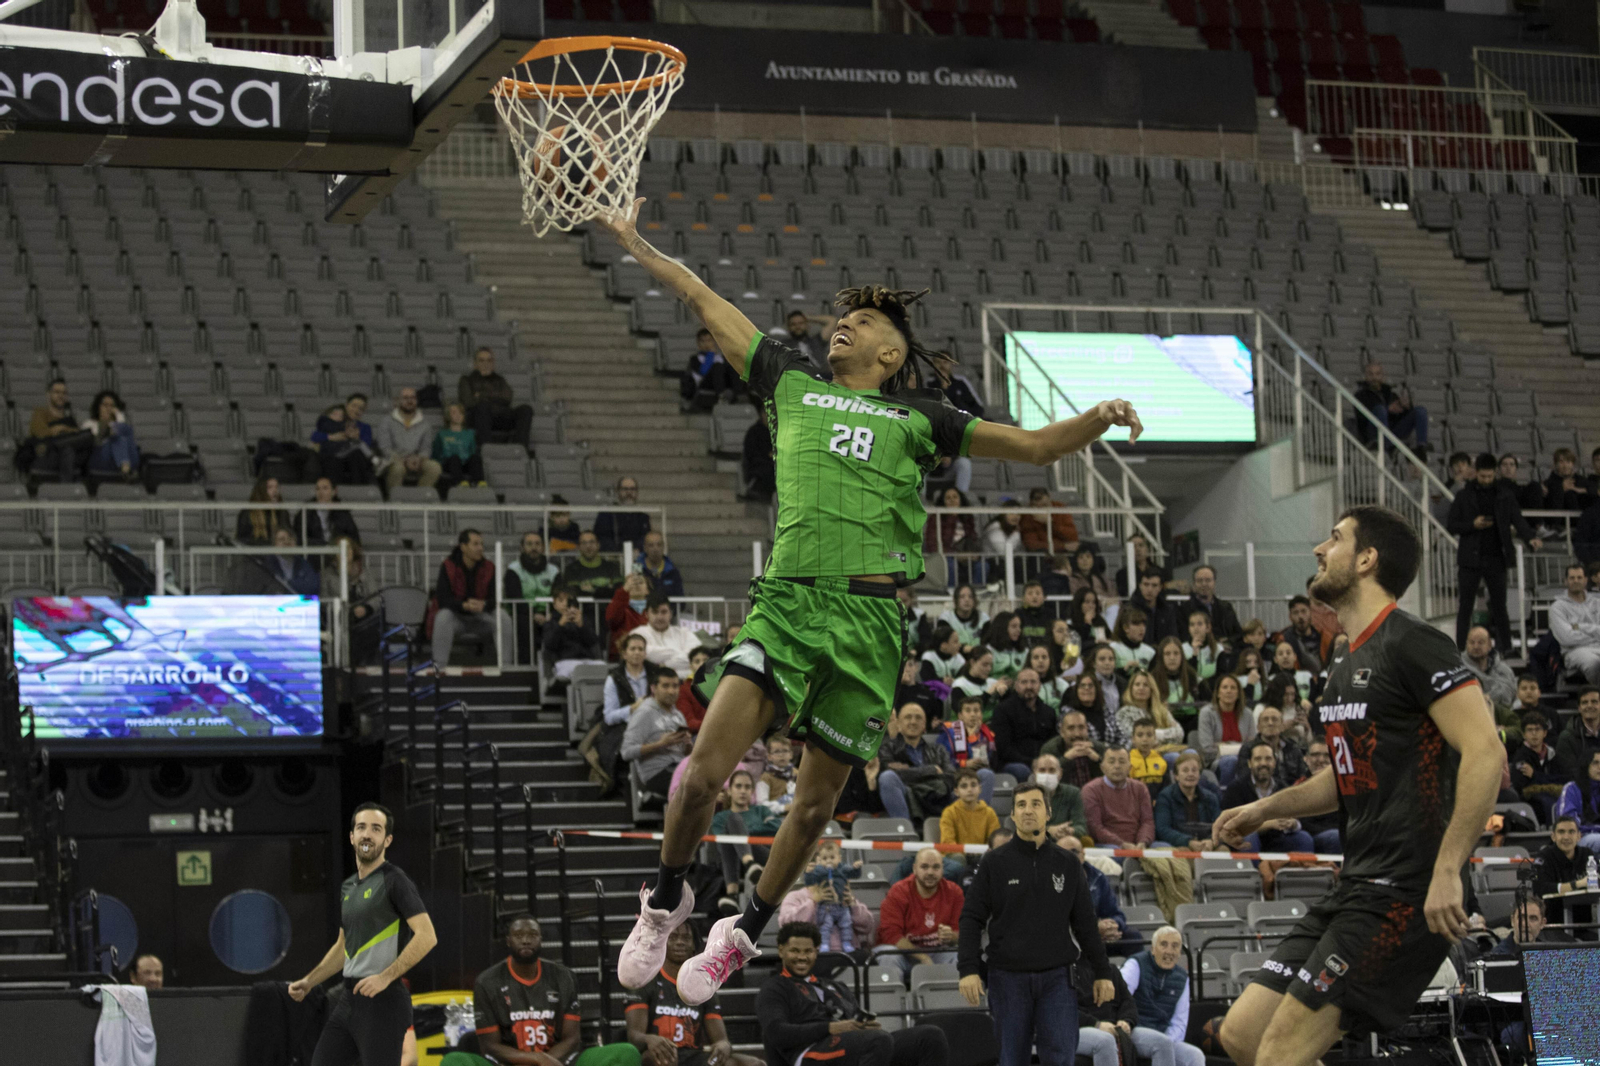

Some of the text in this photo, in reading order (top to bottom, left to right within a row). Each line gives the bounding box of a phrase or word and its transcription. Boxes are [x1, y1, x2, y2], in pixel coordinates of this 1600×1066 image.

[764, 60, 1017, 88] AYUNTAMIENTO DE GRANADA
[829, 423, 875, 462] 28
[79, 664, 250, 684] DESARROLLO
[818, 720, 853, 748] BERNER
[1332, 736, 1355, 775] 21
[524, 1025, 548, 1046] 35
[672, 1023, 685, 1042] 3
